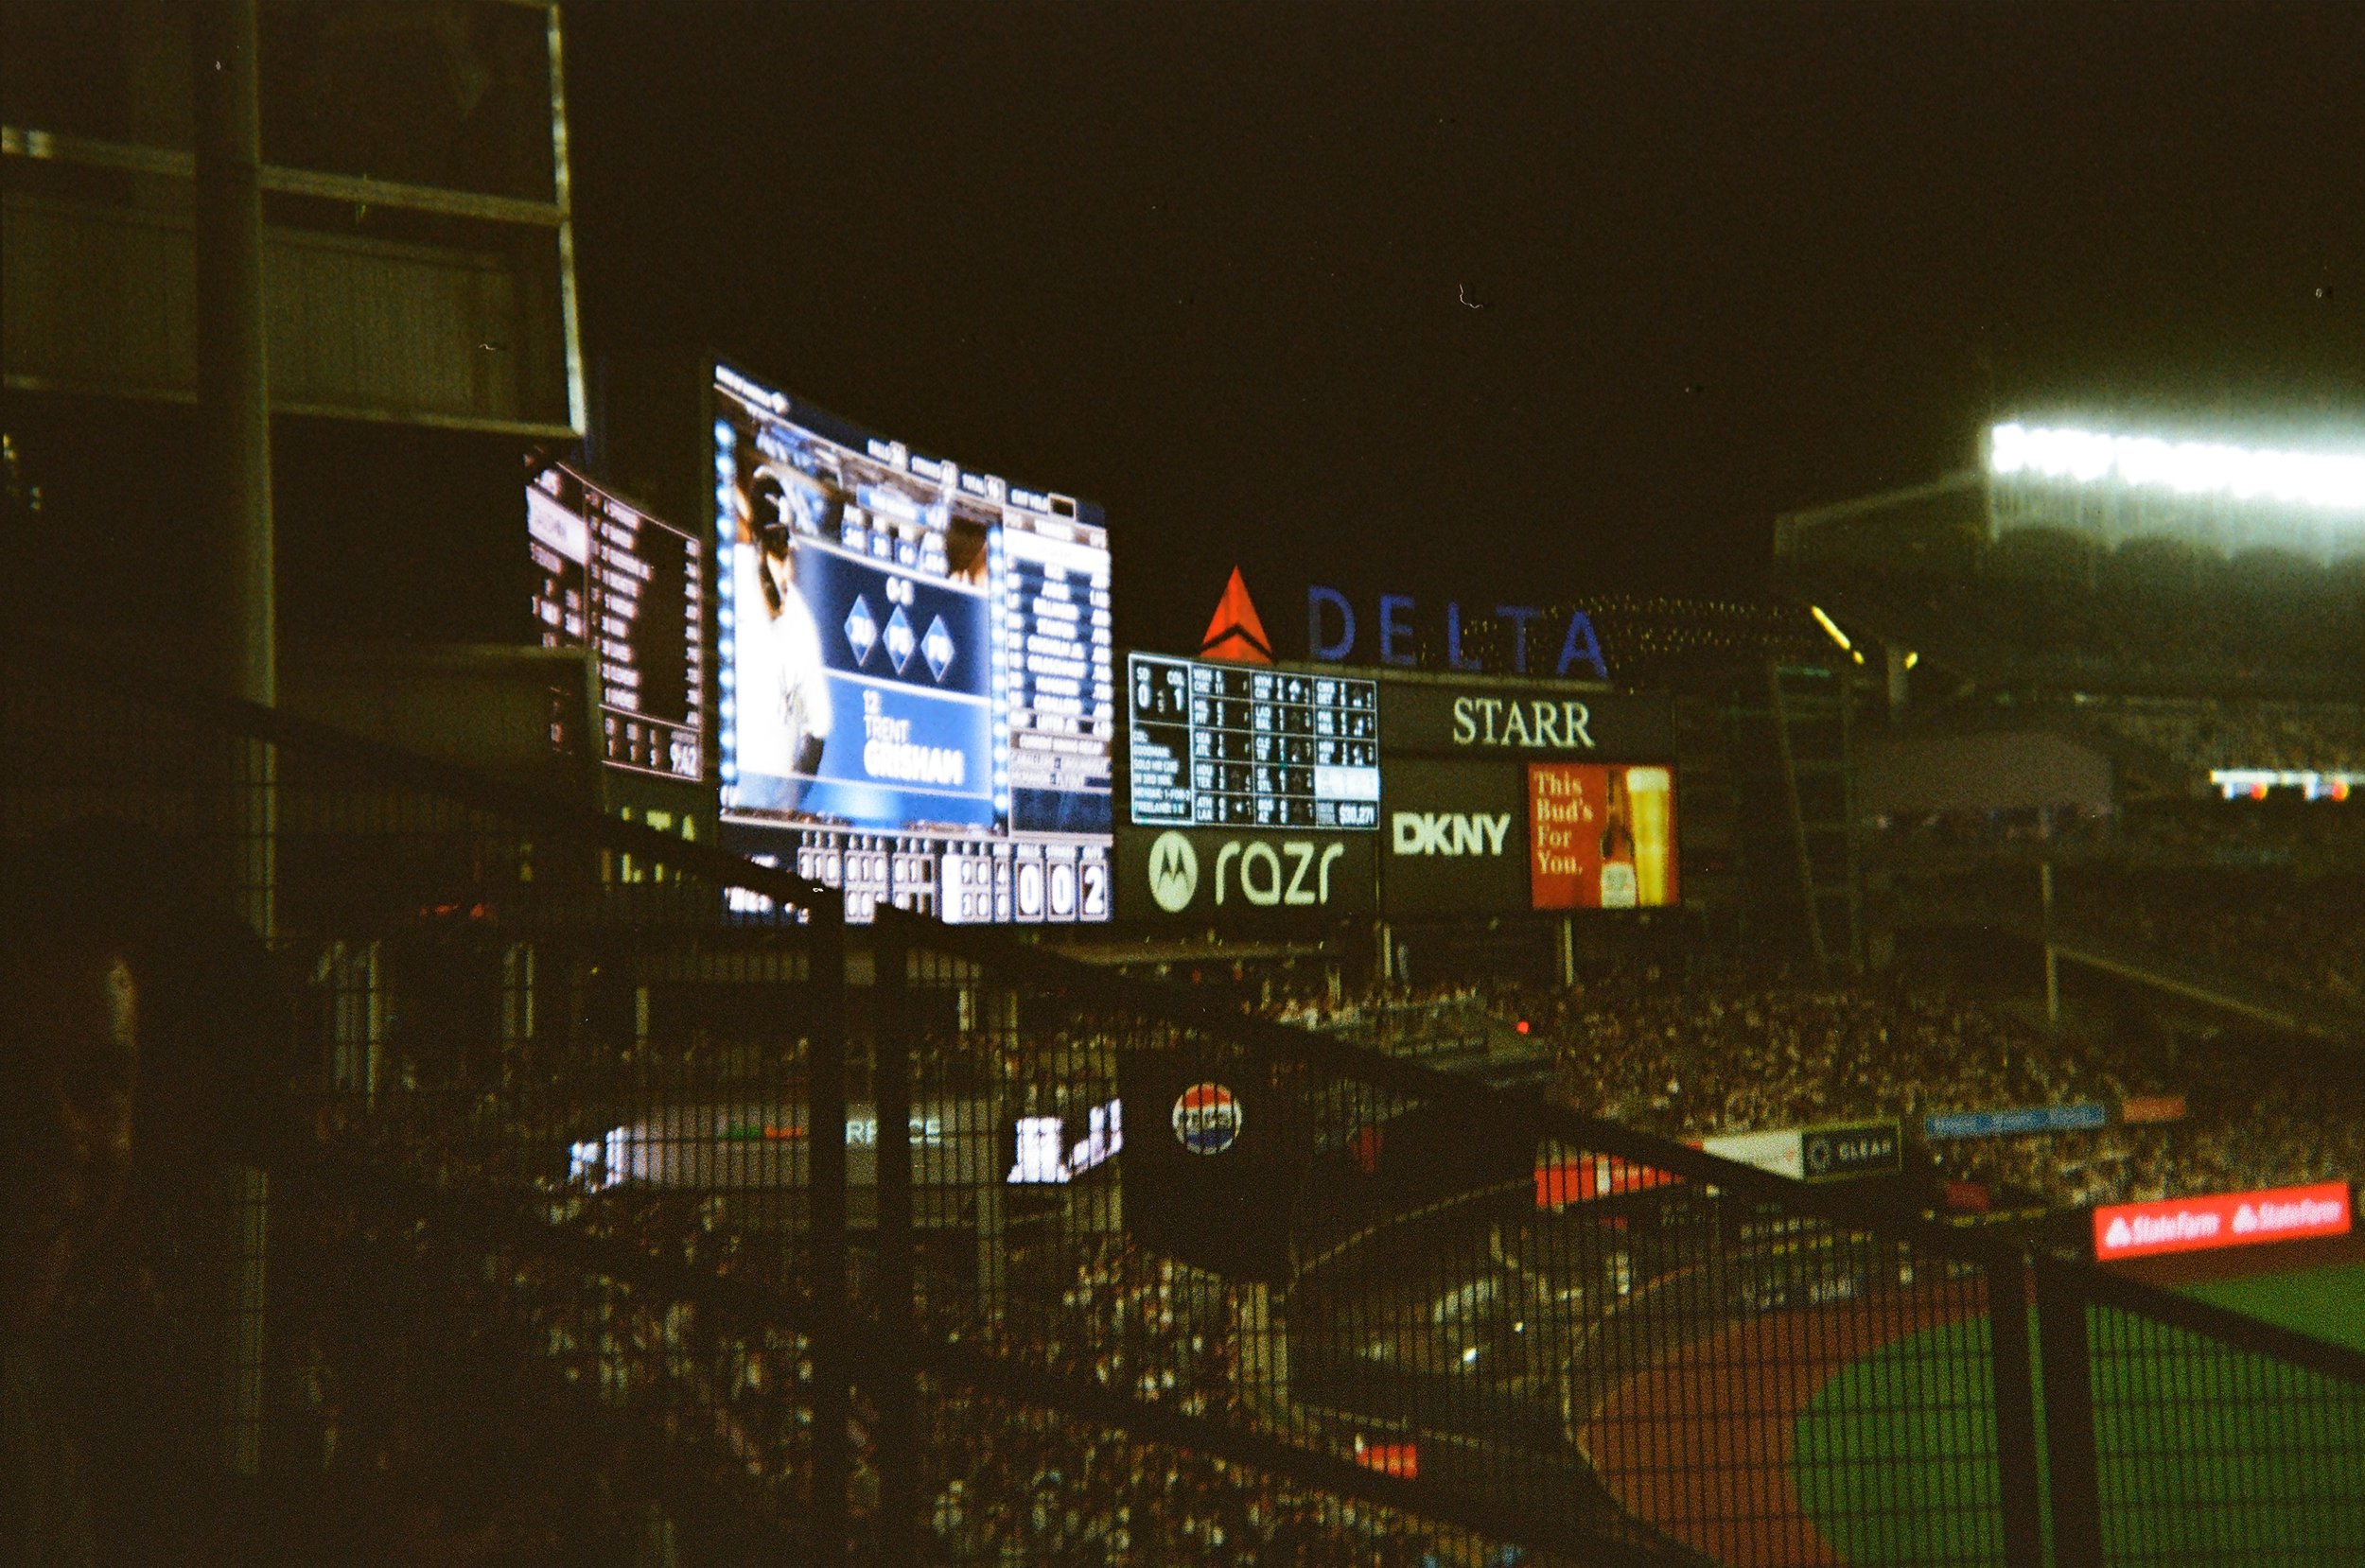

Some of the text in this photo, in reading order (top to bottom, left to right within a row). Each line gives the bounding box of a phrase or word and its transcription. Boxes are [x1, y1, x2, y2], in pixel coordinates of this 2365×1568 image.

[1307, 584, 1608, 679] DELTA
[1138, 683, 1151, 708] 0
[1174, 688, 1183, 711] 1
[864, 713, 910, 743] TRENT
[1453, 696, 1596, 748] STARR
[864, 739, 964, 786] GRISHAM
[1533, 771, 1583, 796] This
[1536, 797, 1593, 823] Bud's
[1393, 811, 1511, 856] DKNY
[1537, 824, 1572, 848] For
[1216, 841, 1343, 905] razr
[1536, 849, 1584, 875] You.
[1020, 863, 1104, 915] 0 0 2
[1838, 1139, 1892, 1162] CLEAR
